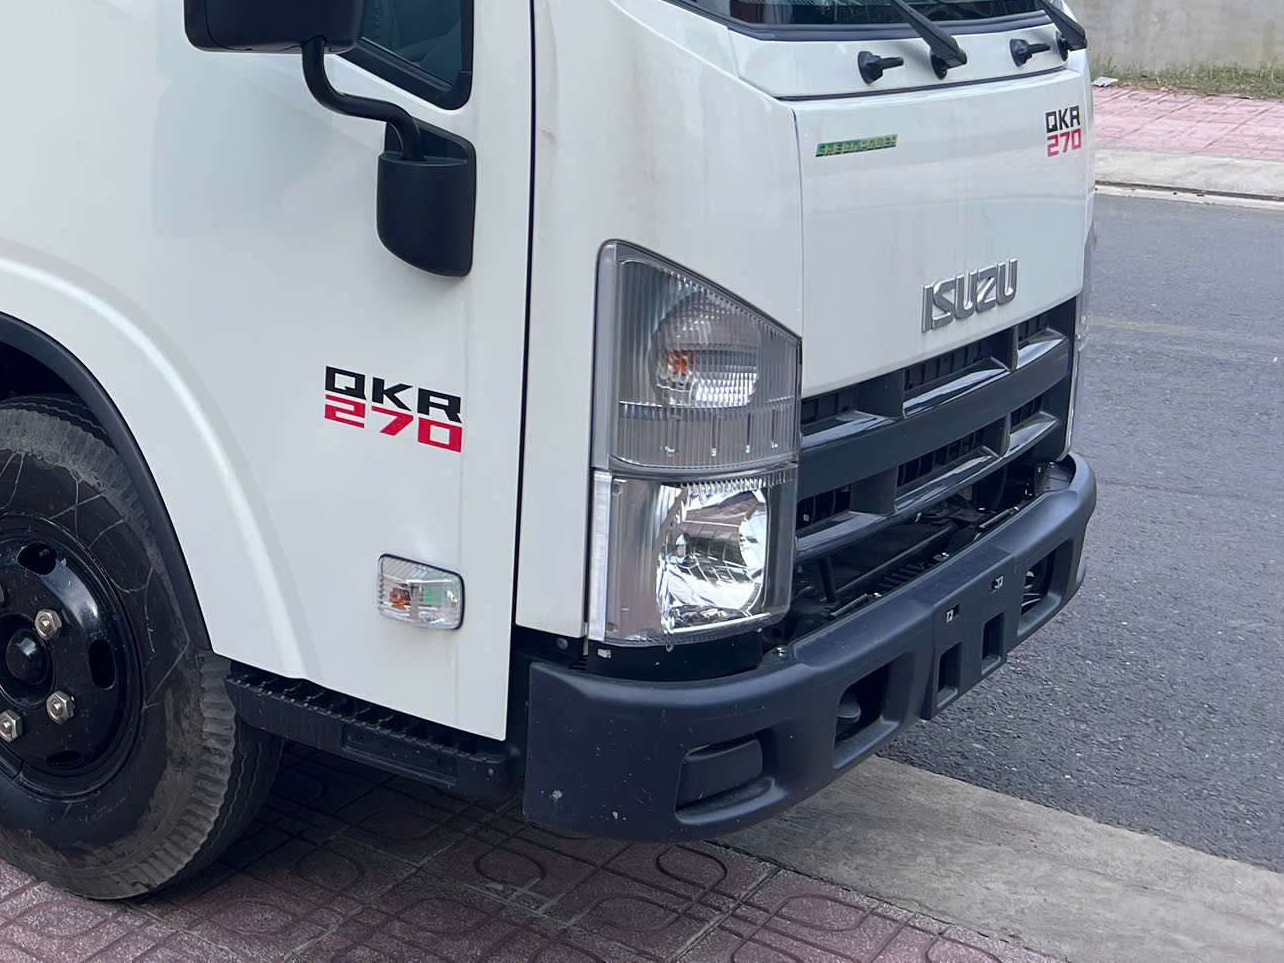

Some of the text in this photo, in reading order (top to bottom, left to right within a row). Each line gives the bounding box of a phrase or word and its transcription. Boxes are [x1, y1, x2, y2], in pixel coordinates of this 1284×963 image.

[1045, 105, 1081, 134] QKR
[1047, 128, 1082, 157] 270
[922, 259, 1018, 333] ISUZU
[324, 366, 462, 423] QKR
[324, 394, 463, 453] 270
